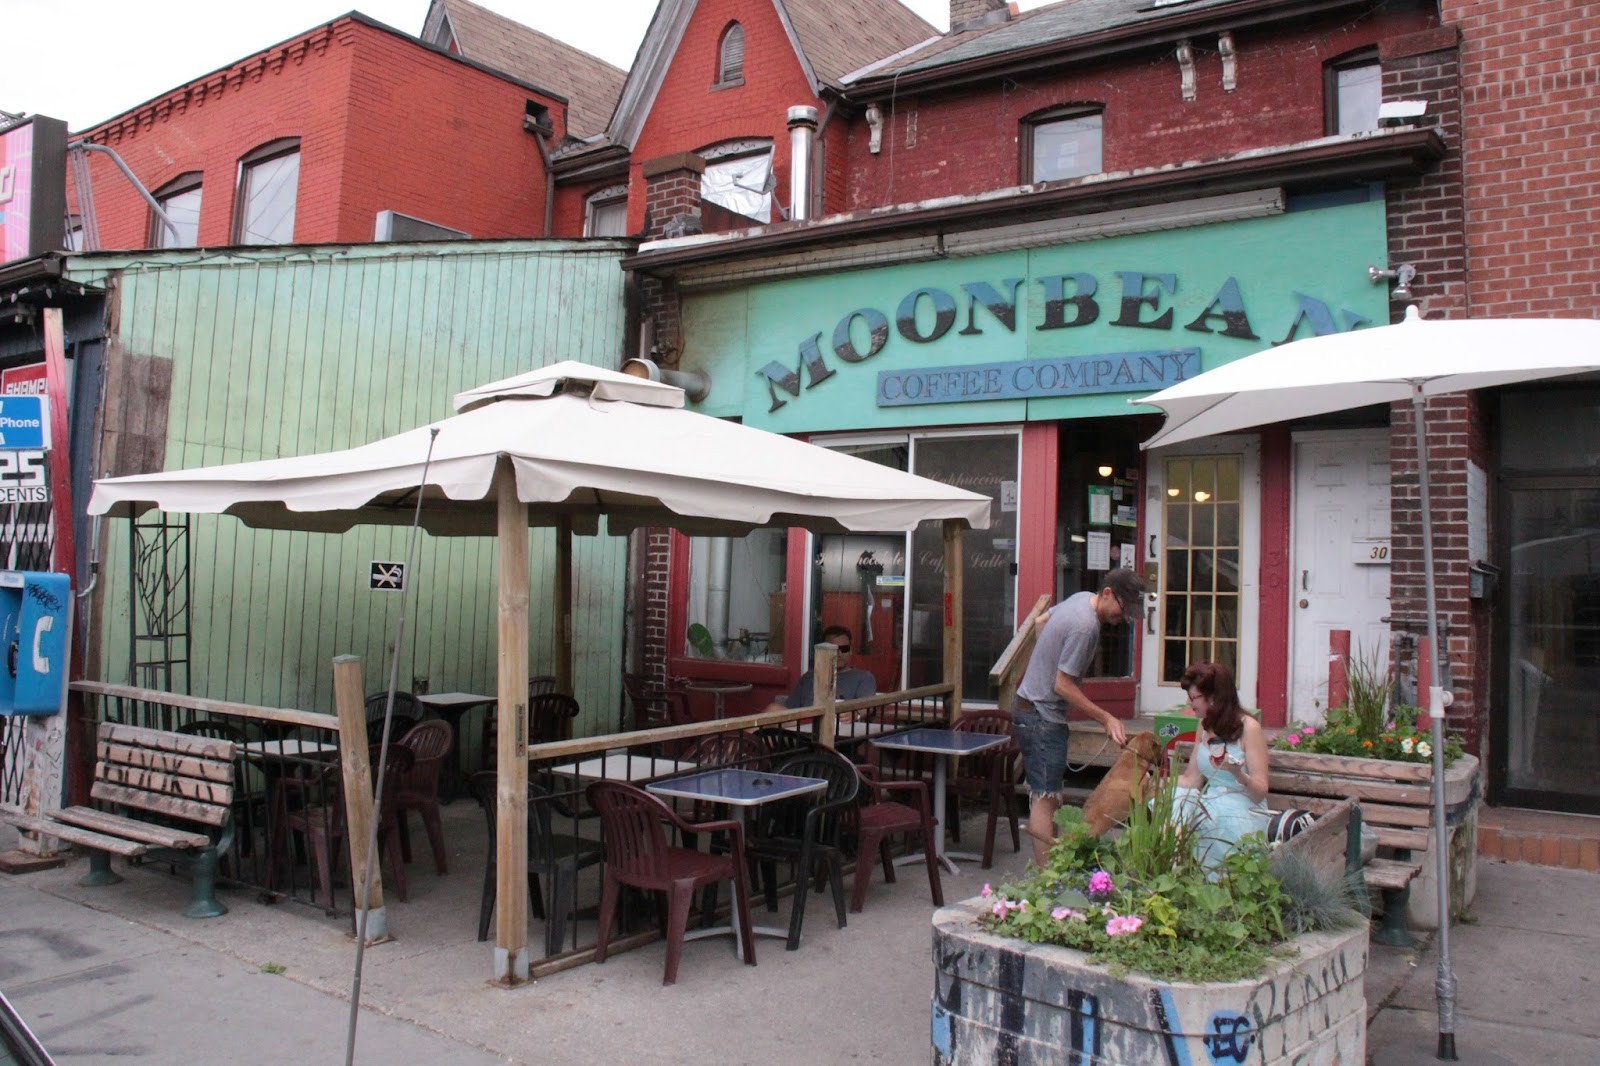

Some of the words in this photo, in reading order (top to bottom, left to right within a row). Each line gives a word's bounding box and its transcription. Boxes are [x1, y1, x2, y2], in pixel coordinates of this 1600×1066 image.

[880, 369, 1003, 400] COFFEE
[1011, 352, 1196, 393] COMPANY
[6, 377, 48, 394] SHAMP
[0, 417, 40, 428] Phone
[1370, 546, 1388, 559] 30
